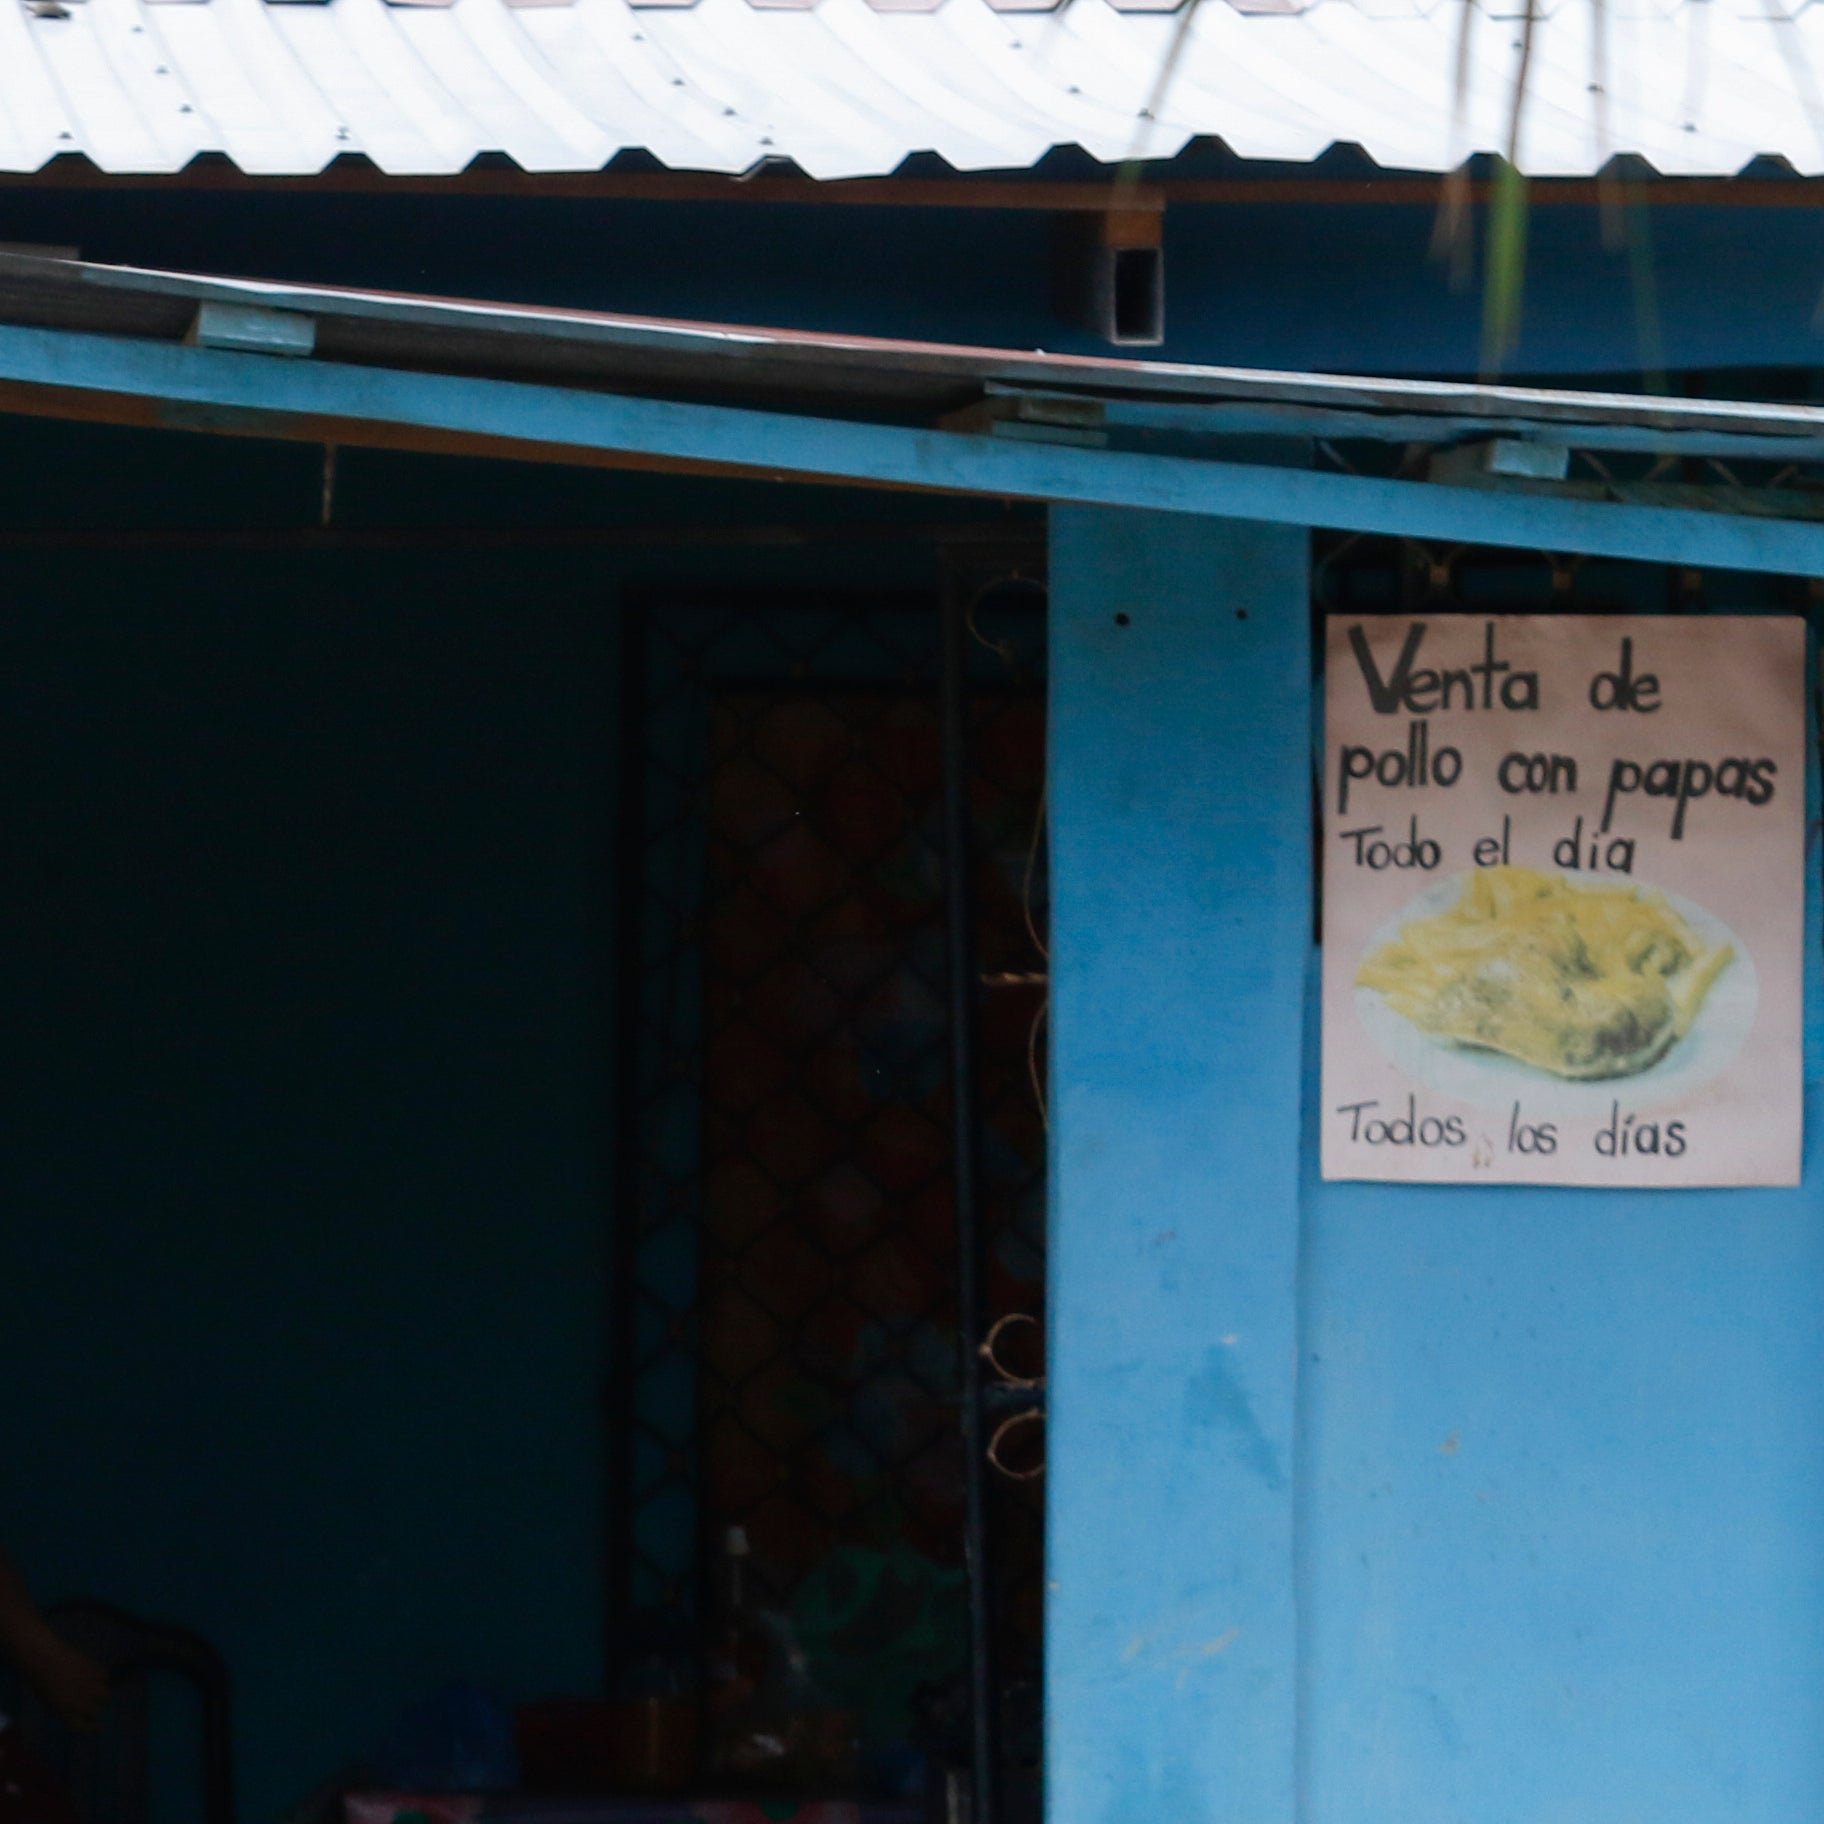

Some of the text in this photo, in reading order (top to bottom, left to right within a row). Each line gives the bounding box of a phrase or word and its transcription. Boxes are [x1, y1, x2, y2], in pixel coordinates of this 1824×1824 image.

[1347, 621, 1663, 714] Venta de
[1337, 720, 1778, 841] pollo con papas
[1339, 814, 1442, 871] Todo
[1473, 815, 1510, 867] el
[1337, 1094, 1466, 1147] Todos
[1508, 1101, 1559, 1156] los
